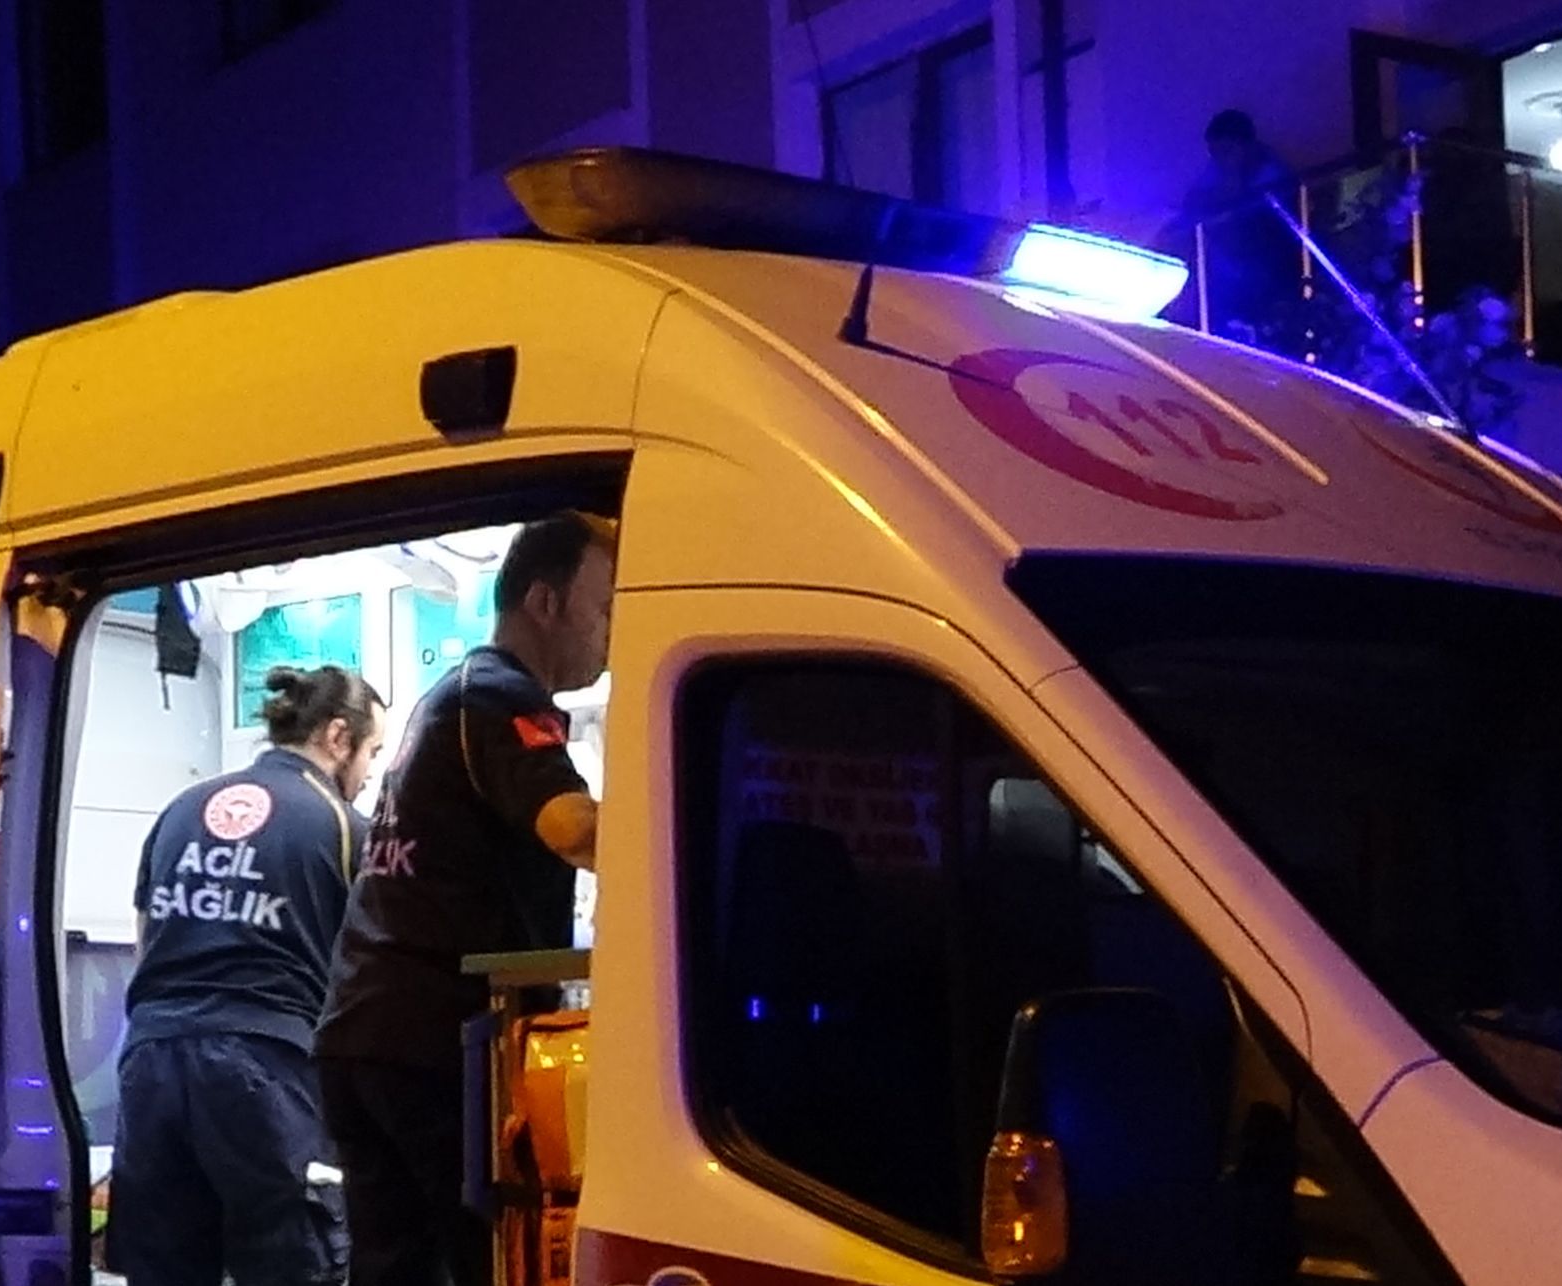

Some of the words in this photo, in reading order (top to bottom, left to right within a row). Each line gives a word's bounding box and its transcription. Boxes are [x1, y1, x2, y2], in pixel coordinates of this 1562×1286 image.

[1067, 391, 1262, 465] 112
[175, 839, 264, 881] ACİL
[148, 881, 289, 931] SAĞLIK
